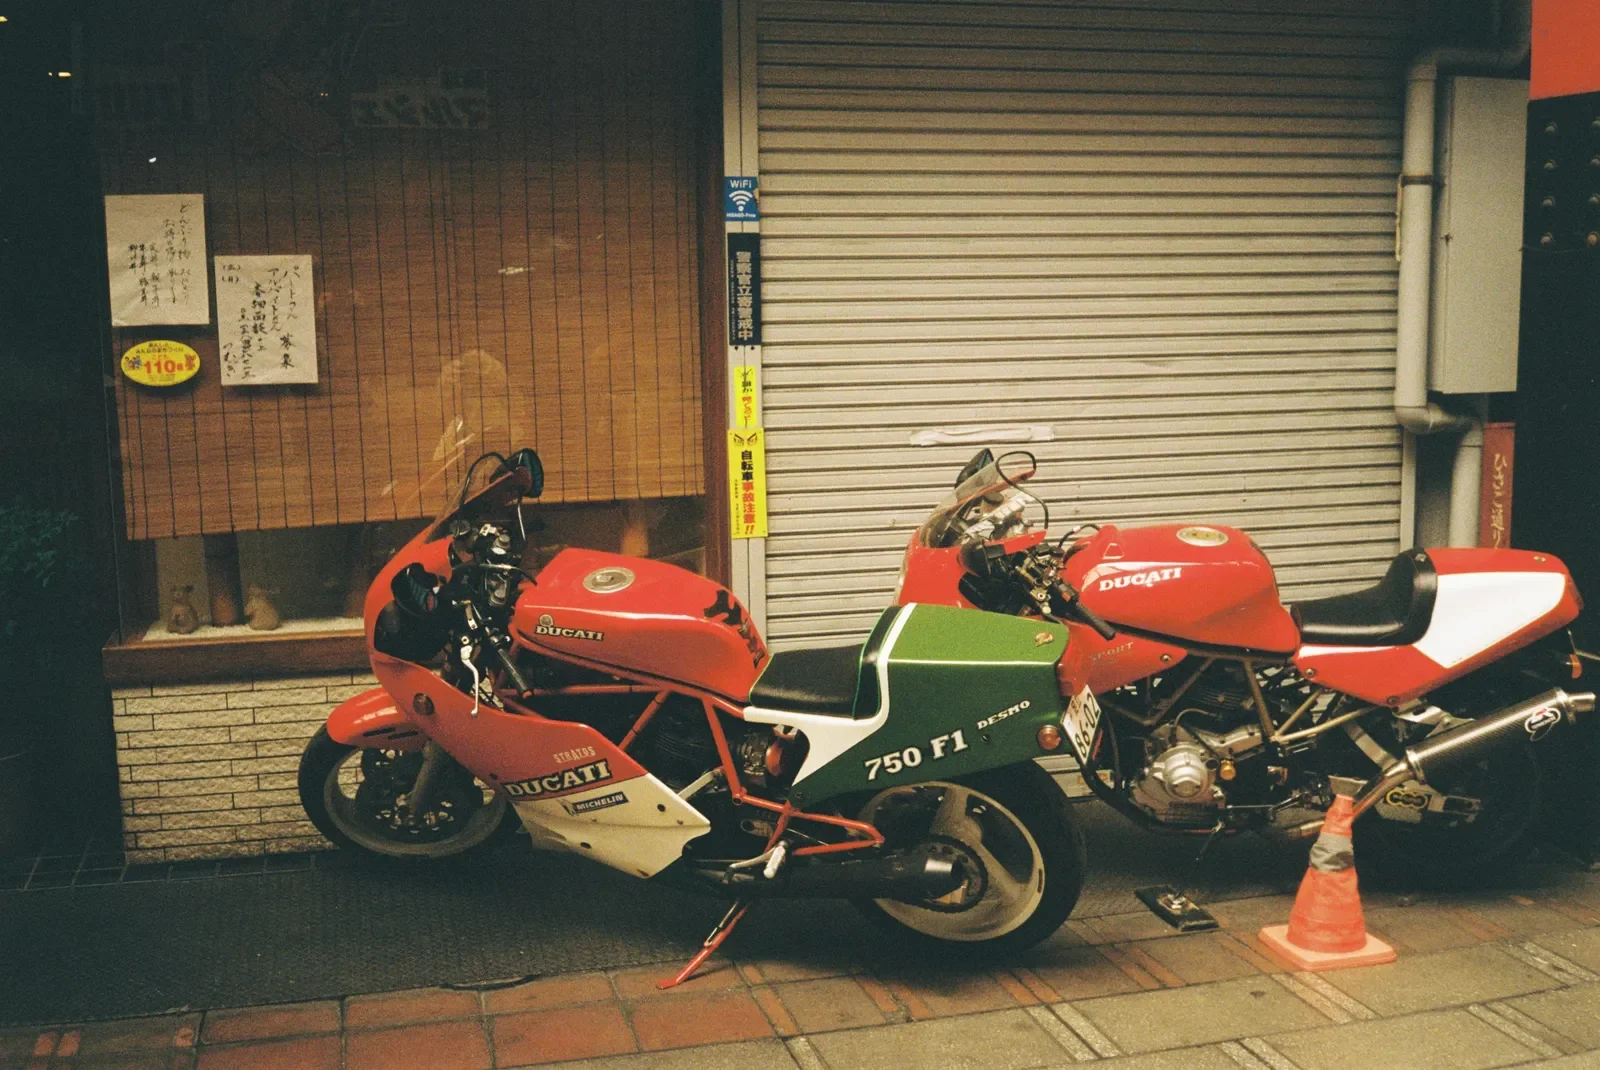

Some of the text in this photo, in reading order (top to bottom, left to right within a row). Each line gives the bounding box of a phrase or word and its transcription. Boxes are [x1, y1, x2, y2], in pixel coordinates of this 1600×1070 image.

[1098, 567, 1183, 592] DUCATI
[535, 624, 604, 641] DUCATI
[864, 746, 923, 781] 750
[929, 729, 970, 760] F1
[976, 699, 1032, 730] DESMO
[553, 746, 597, 764] STRATOS
[504, 758, 612, 798] DUCATI
[575, 794, 625, 811] MICHELIN
